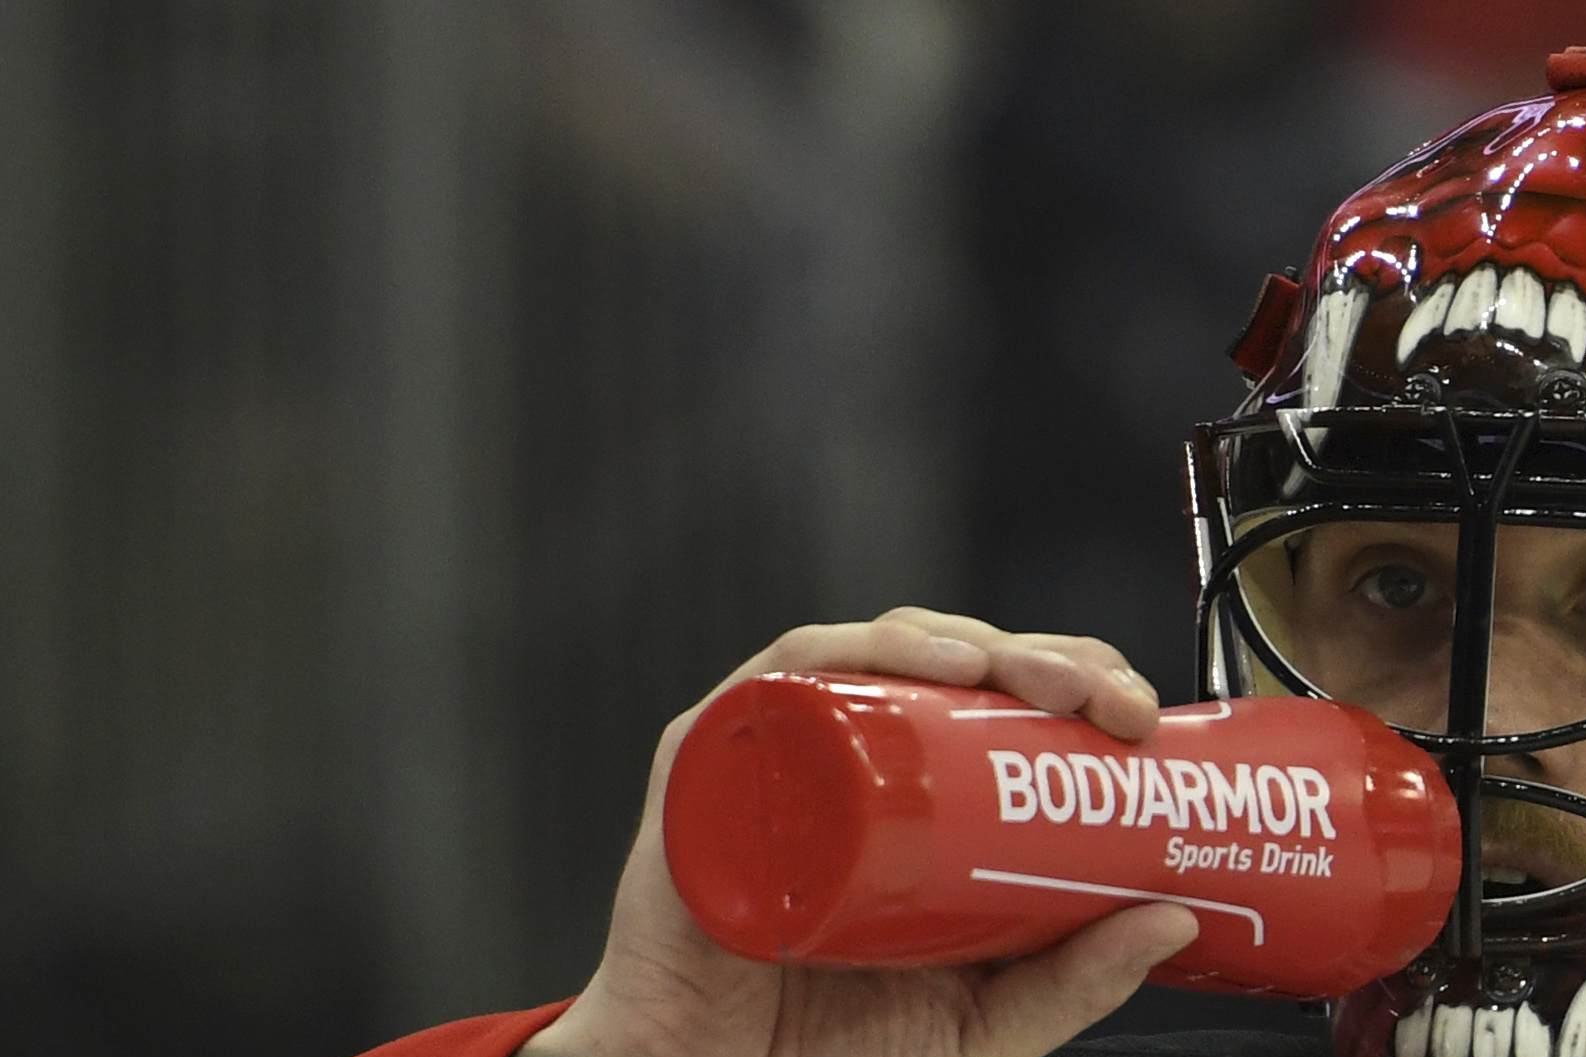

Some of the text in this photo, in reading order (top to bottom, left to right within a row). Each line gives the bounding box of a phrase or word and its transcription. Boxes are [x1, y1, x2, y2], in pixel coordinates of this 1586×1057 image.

[988, 750, 1336, 839] BODYARMOR
[1165, 836, 1334, 877] Sports Drink
